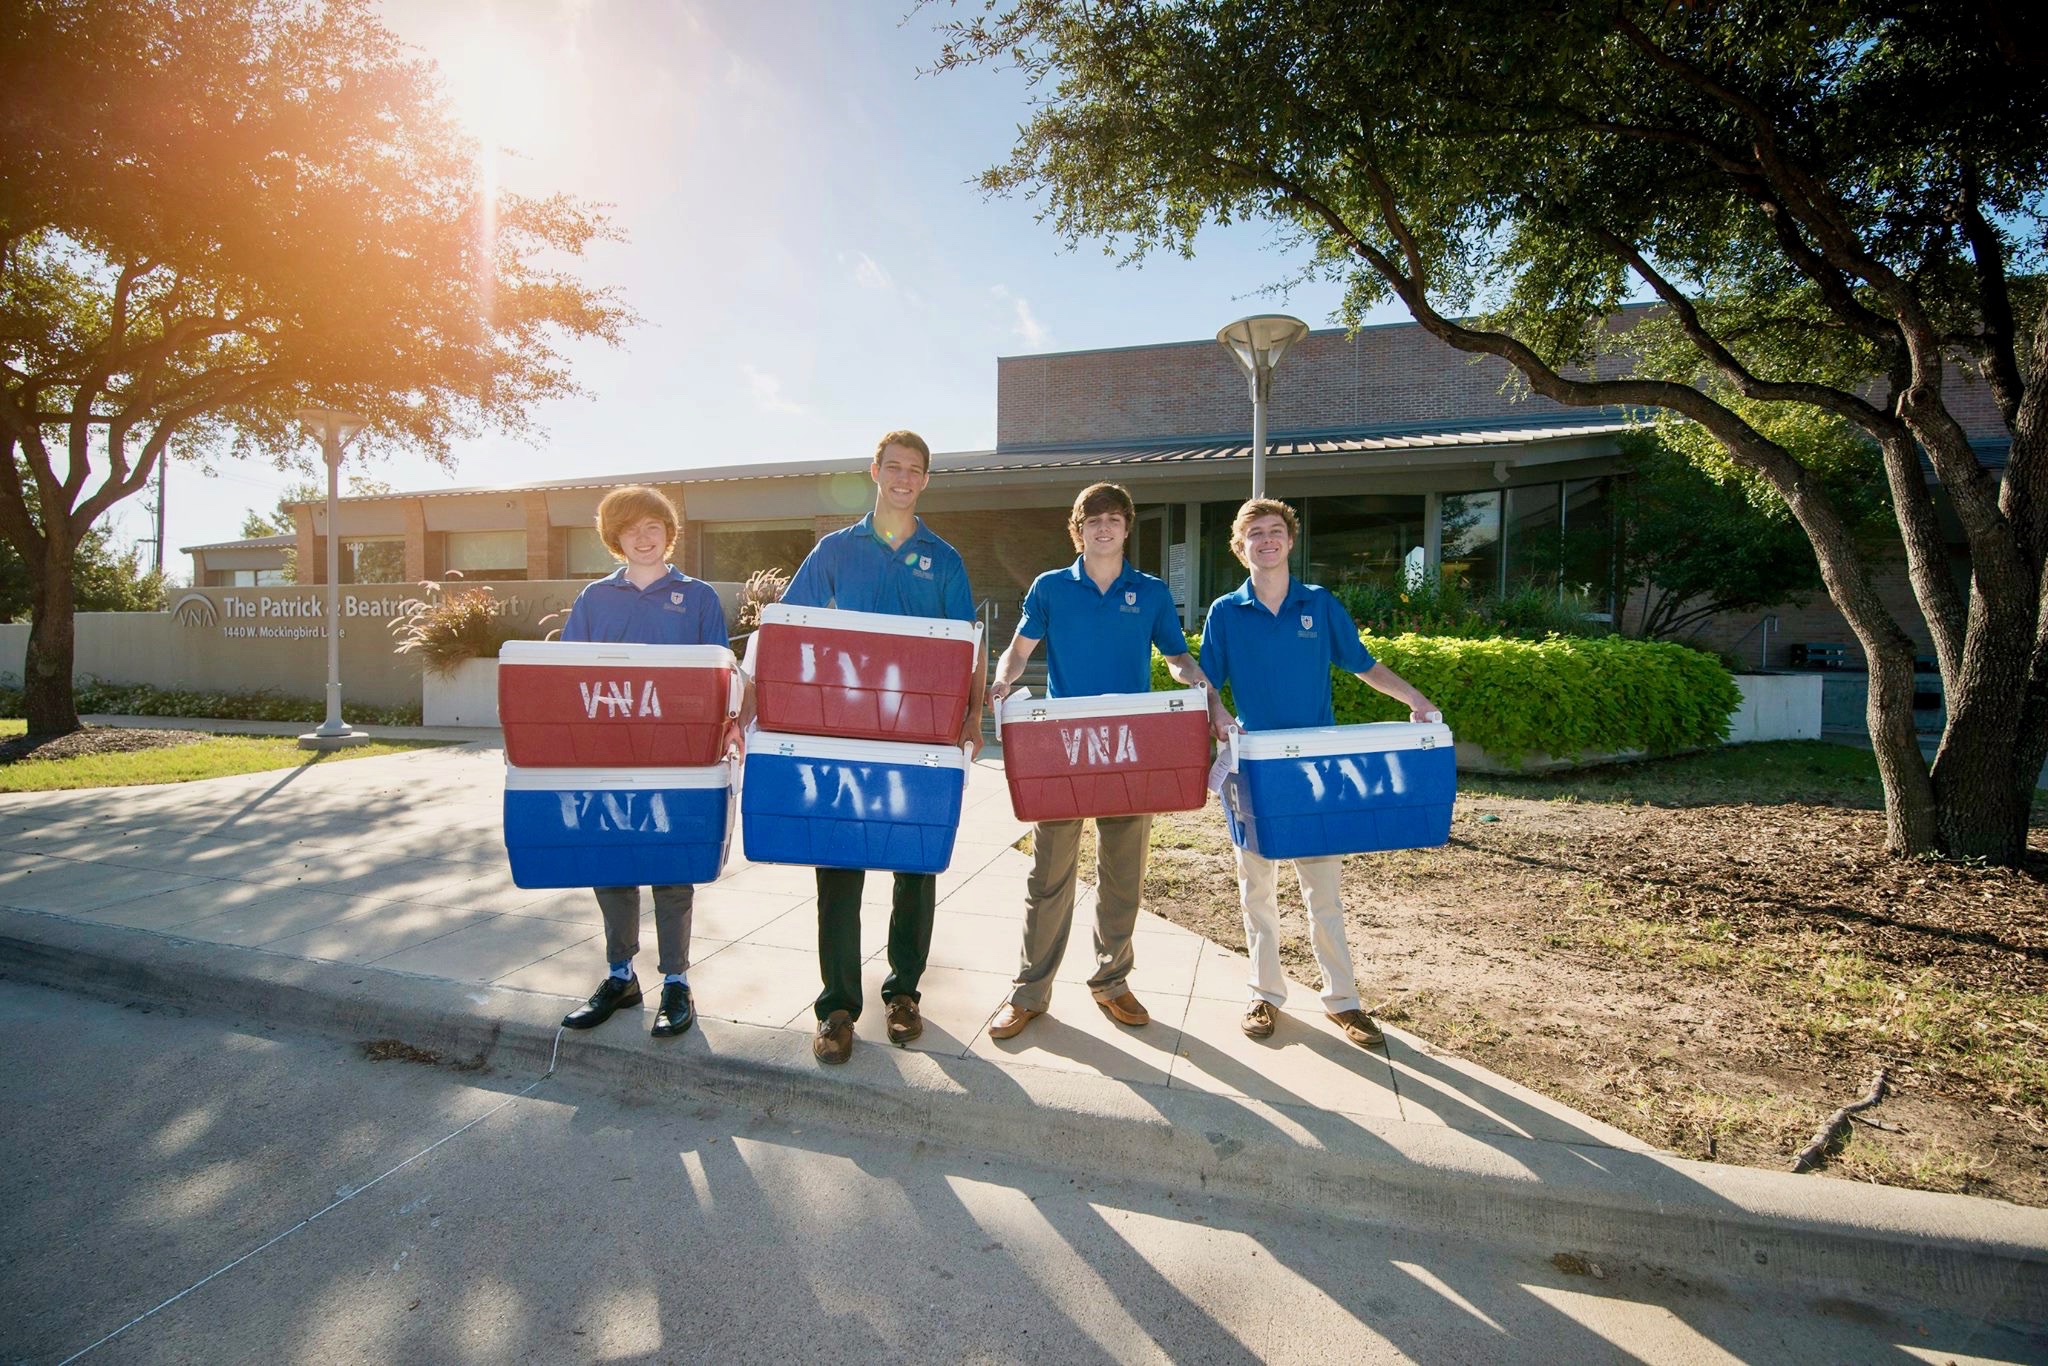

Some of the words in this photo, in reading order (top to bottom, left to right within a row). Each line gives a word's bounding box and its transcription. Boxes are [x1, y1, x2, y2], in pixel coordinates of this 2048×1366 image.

[178, 608, 214, 627] VNA
[223, 596, 256, 617] The
[260, 595, 323, 617] Patrick
[223, 627, 245, 638] 1440
[246, 627, 258, 638] W.
[259, 626, 319, 640] Mockingbird
[321, 627, 345, 638] Le
[579, 680, 662, 718] VNA
[1060, 724, 1138, 766] VNA
[555, 791, 671, 834] VNA
